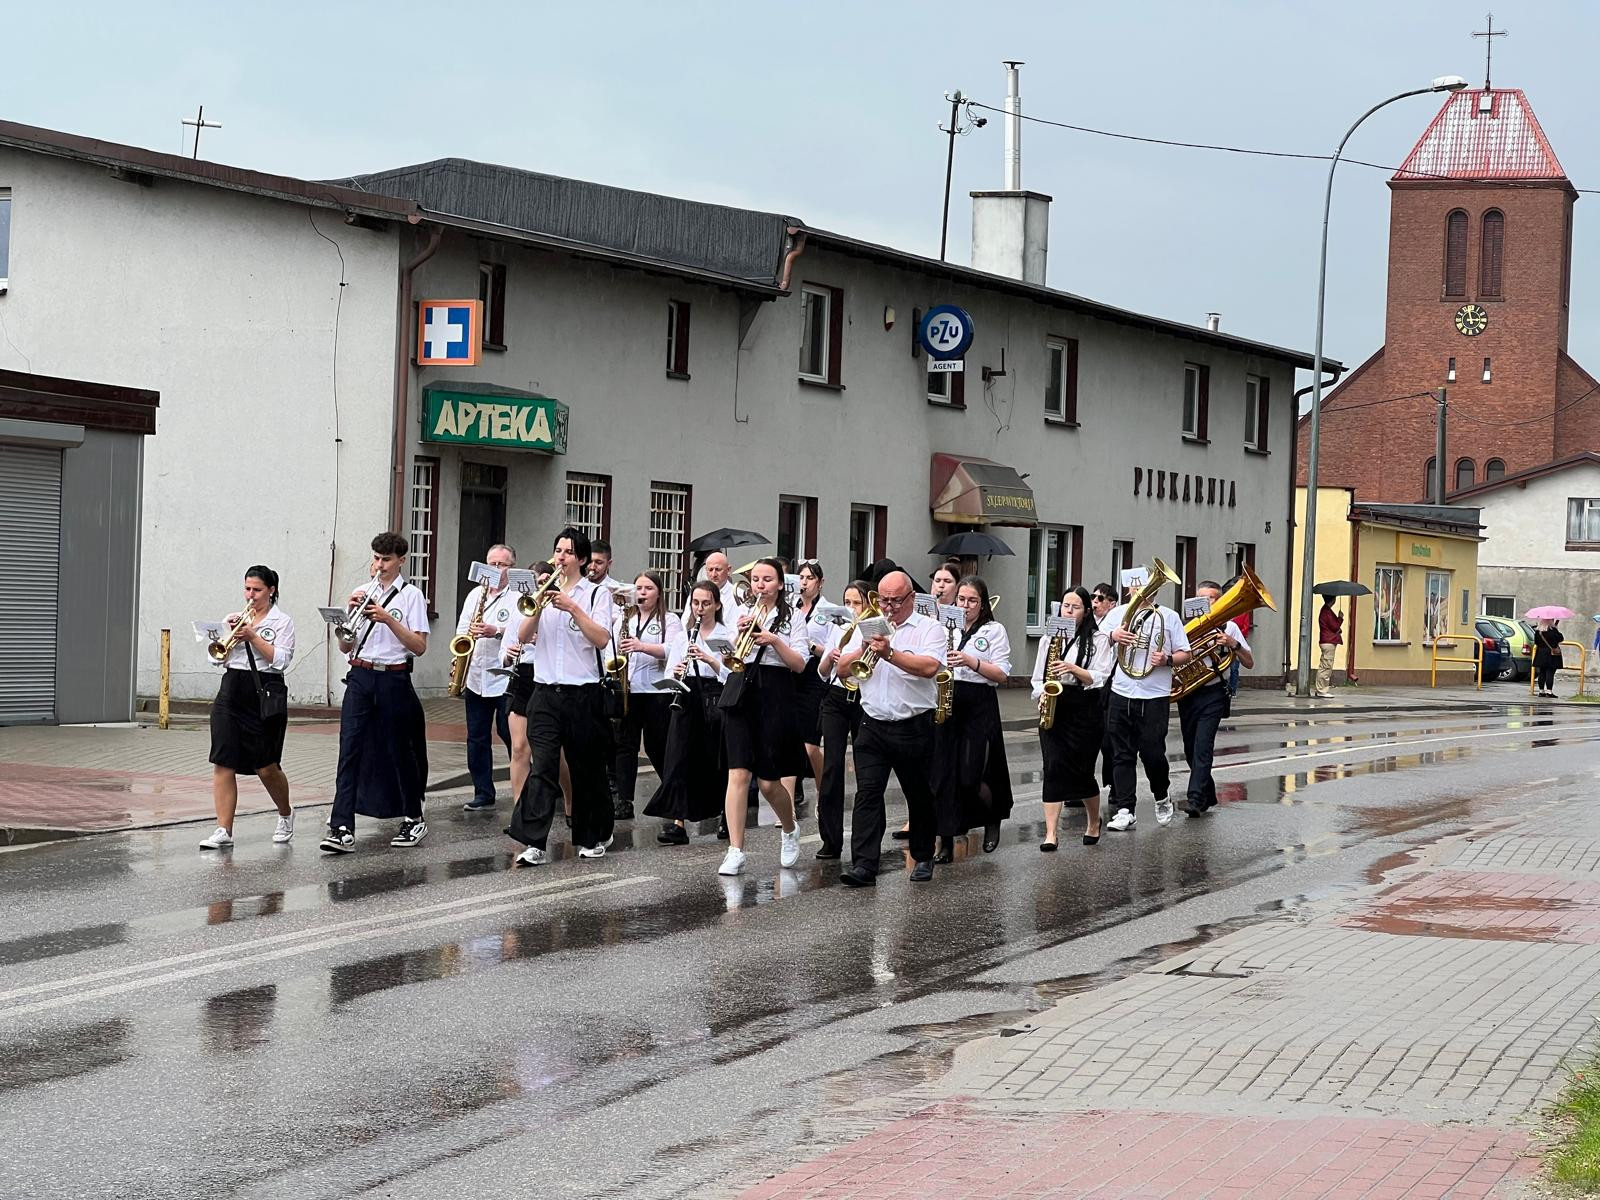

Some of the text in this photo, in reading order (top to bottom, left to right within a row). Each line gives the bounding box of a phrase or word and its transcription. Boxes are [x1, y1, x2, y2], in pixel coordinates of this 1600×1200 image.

[930, 320, 959, 344] PZU
[433, 400, 552, 442] APTEKA
[1134, 467, 1236, 507] PIEKARNIA
